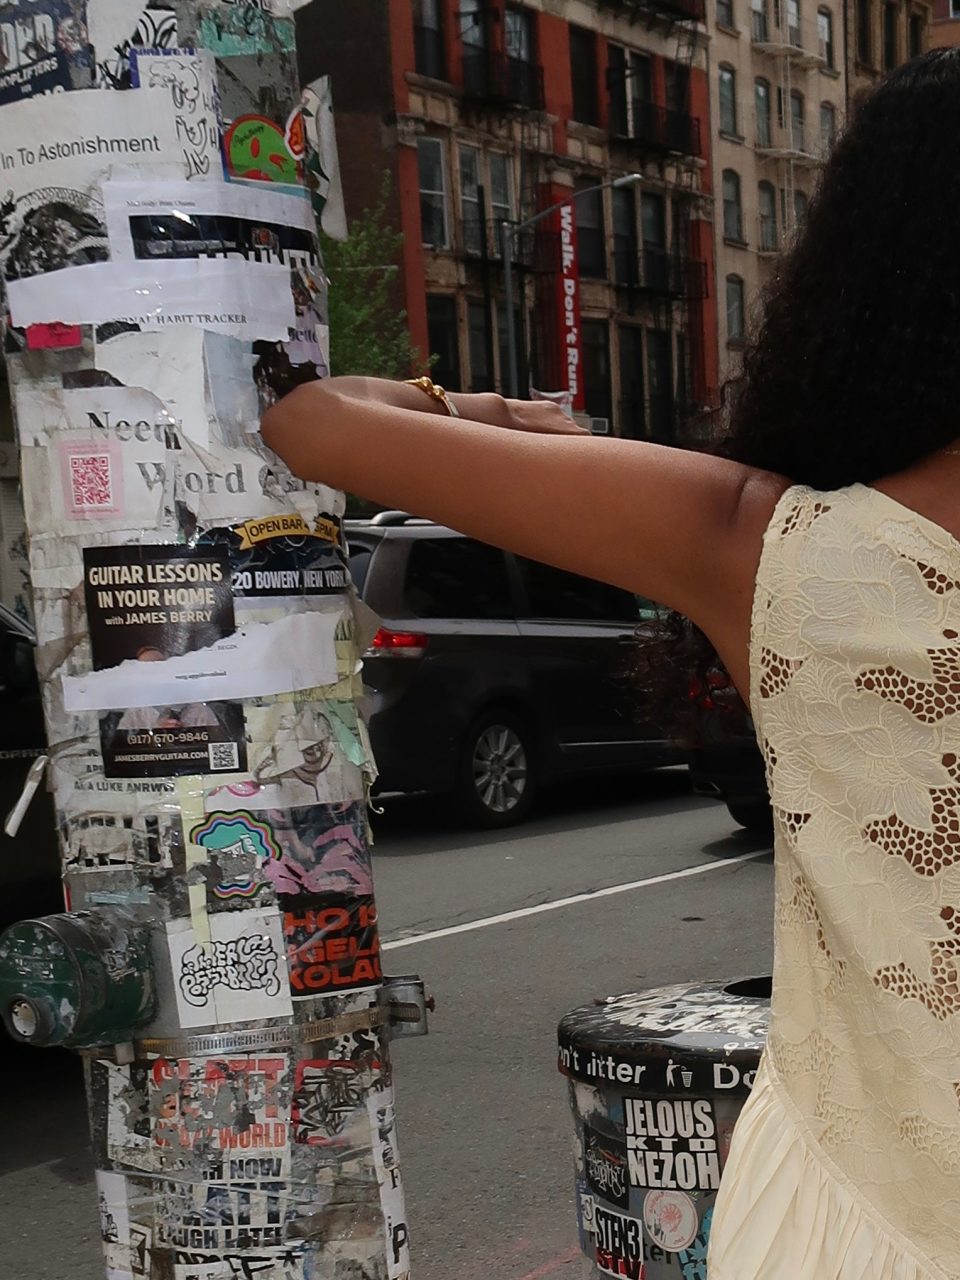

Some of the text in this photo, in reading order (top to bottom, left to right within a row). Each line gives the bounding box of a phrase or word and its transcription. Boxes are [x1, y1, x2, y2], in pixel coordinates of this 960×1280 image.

[1, 136, 161, 170] In To Astonishment
[156, 314, 193, 325] HABIT
[198, 314, 247, 324] TRACKER
[563, 278, 577, 344] Don't
[250, 519, 281, 538] OPEN
[89, 563, 223, 586] GUITAR LESSONS
[303, 570, 324, 588] NEW
[97, 588, 215, 609] IN YOUR HOME
[105, 610, 212, 626] with JAMES BERRY
[154, 731, 208, 744] 670-9846
[114, 751, 208, 763] JAMESBERRYGUITAR.COM
[97, 781, 123, 792] LUKE
[625, 1098, 716, 1138] JELOUS
[219, 1122, 287, 1149] WORLD
[230, 1157, 284, 1180] NOW
[627, 1150, 721, 1191] NEZOH
[594, 1206, 642, 1261] STEN3
